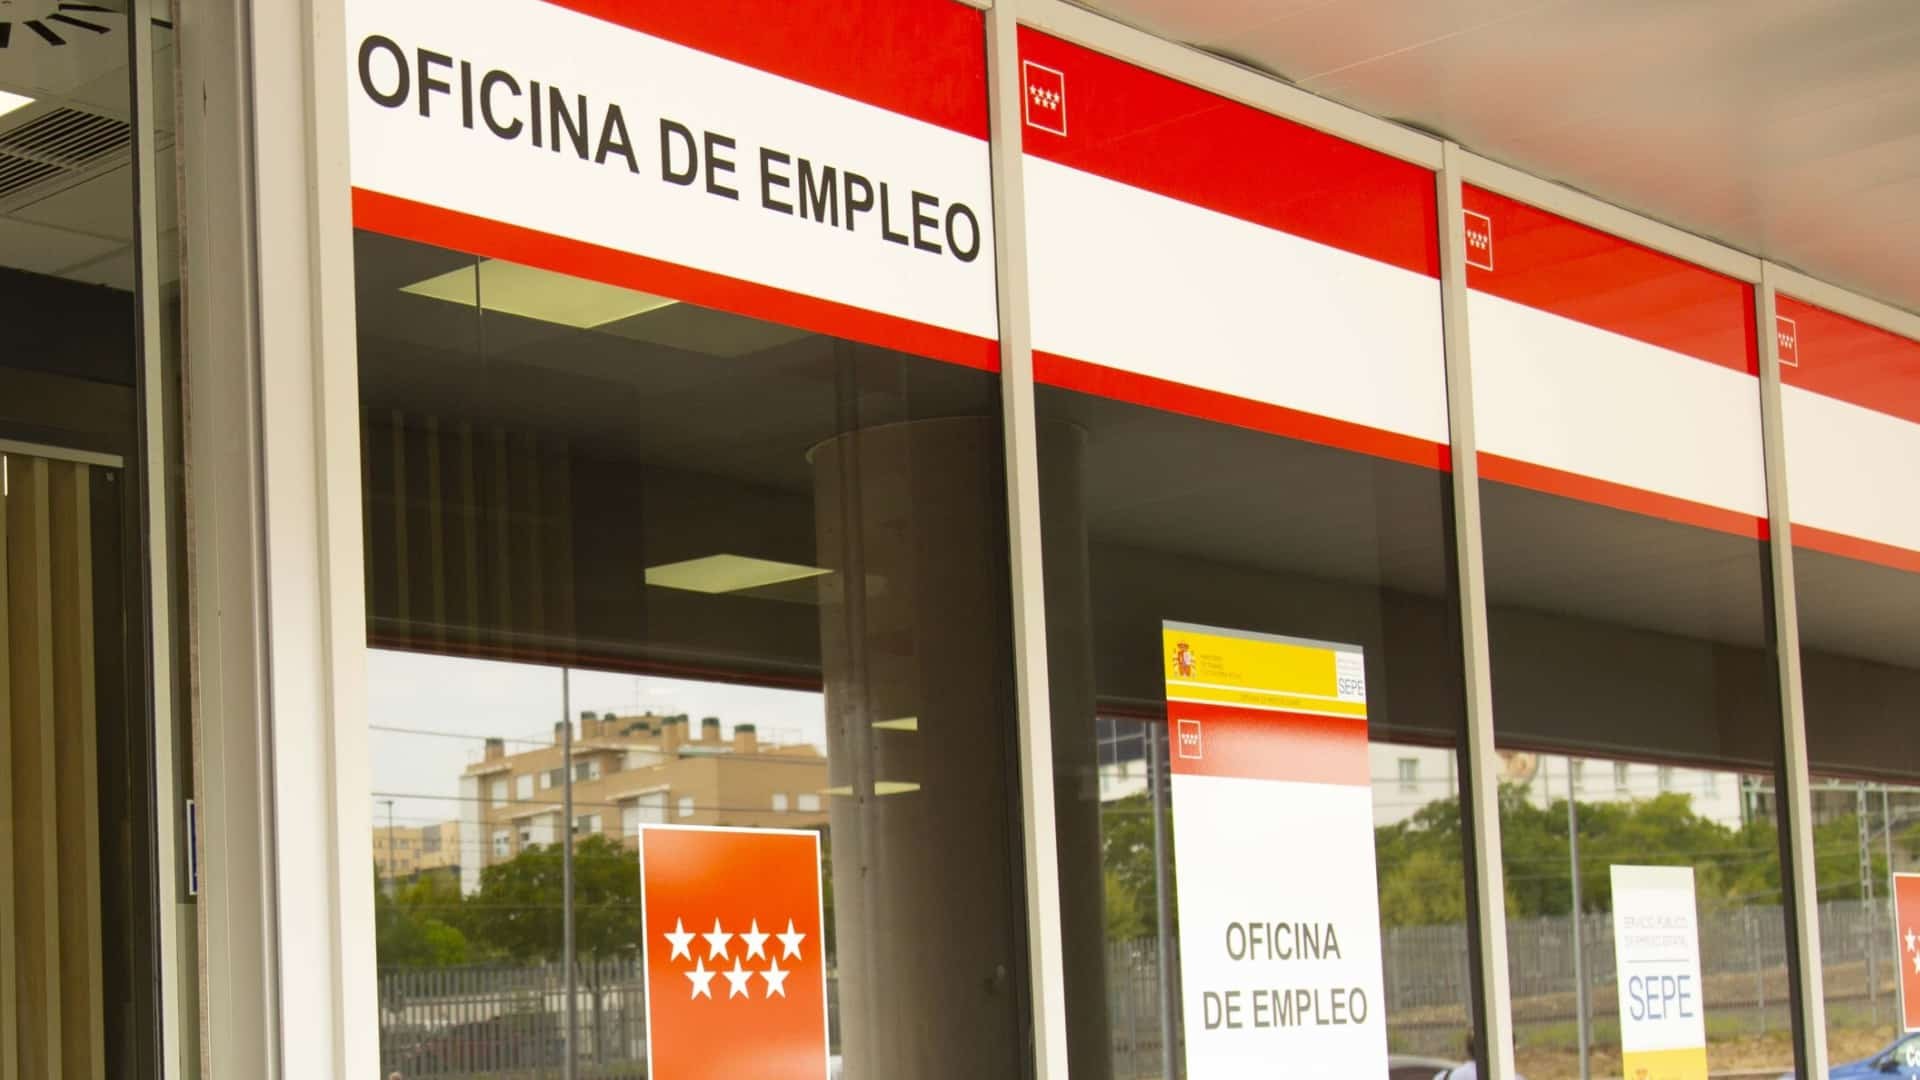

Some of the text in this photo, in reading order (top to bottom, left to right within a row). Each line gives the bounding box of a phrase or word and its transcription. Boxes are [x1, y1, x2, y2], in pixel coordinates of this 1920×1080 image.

[358, 35, 981, 263] OFICINA DE EMPLEO
[1338, 677, 1364, 696] SEPE
[1226, 922, 1341, 960] OFICINA
[1203, 988, 1367, 1029] DE EMPLEO
[1628, 975, 1694, 1021] SEPE
